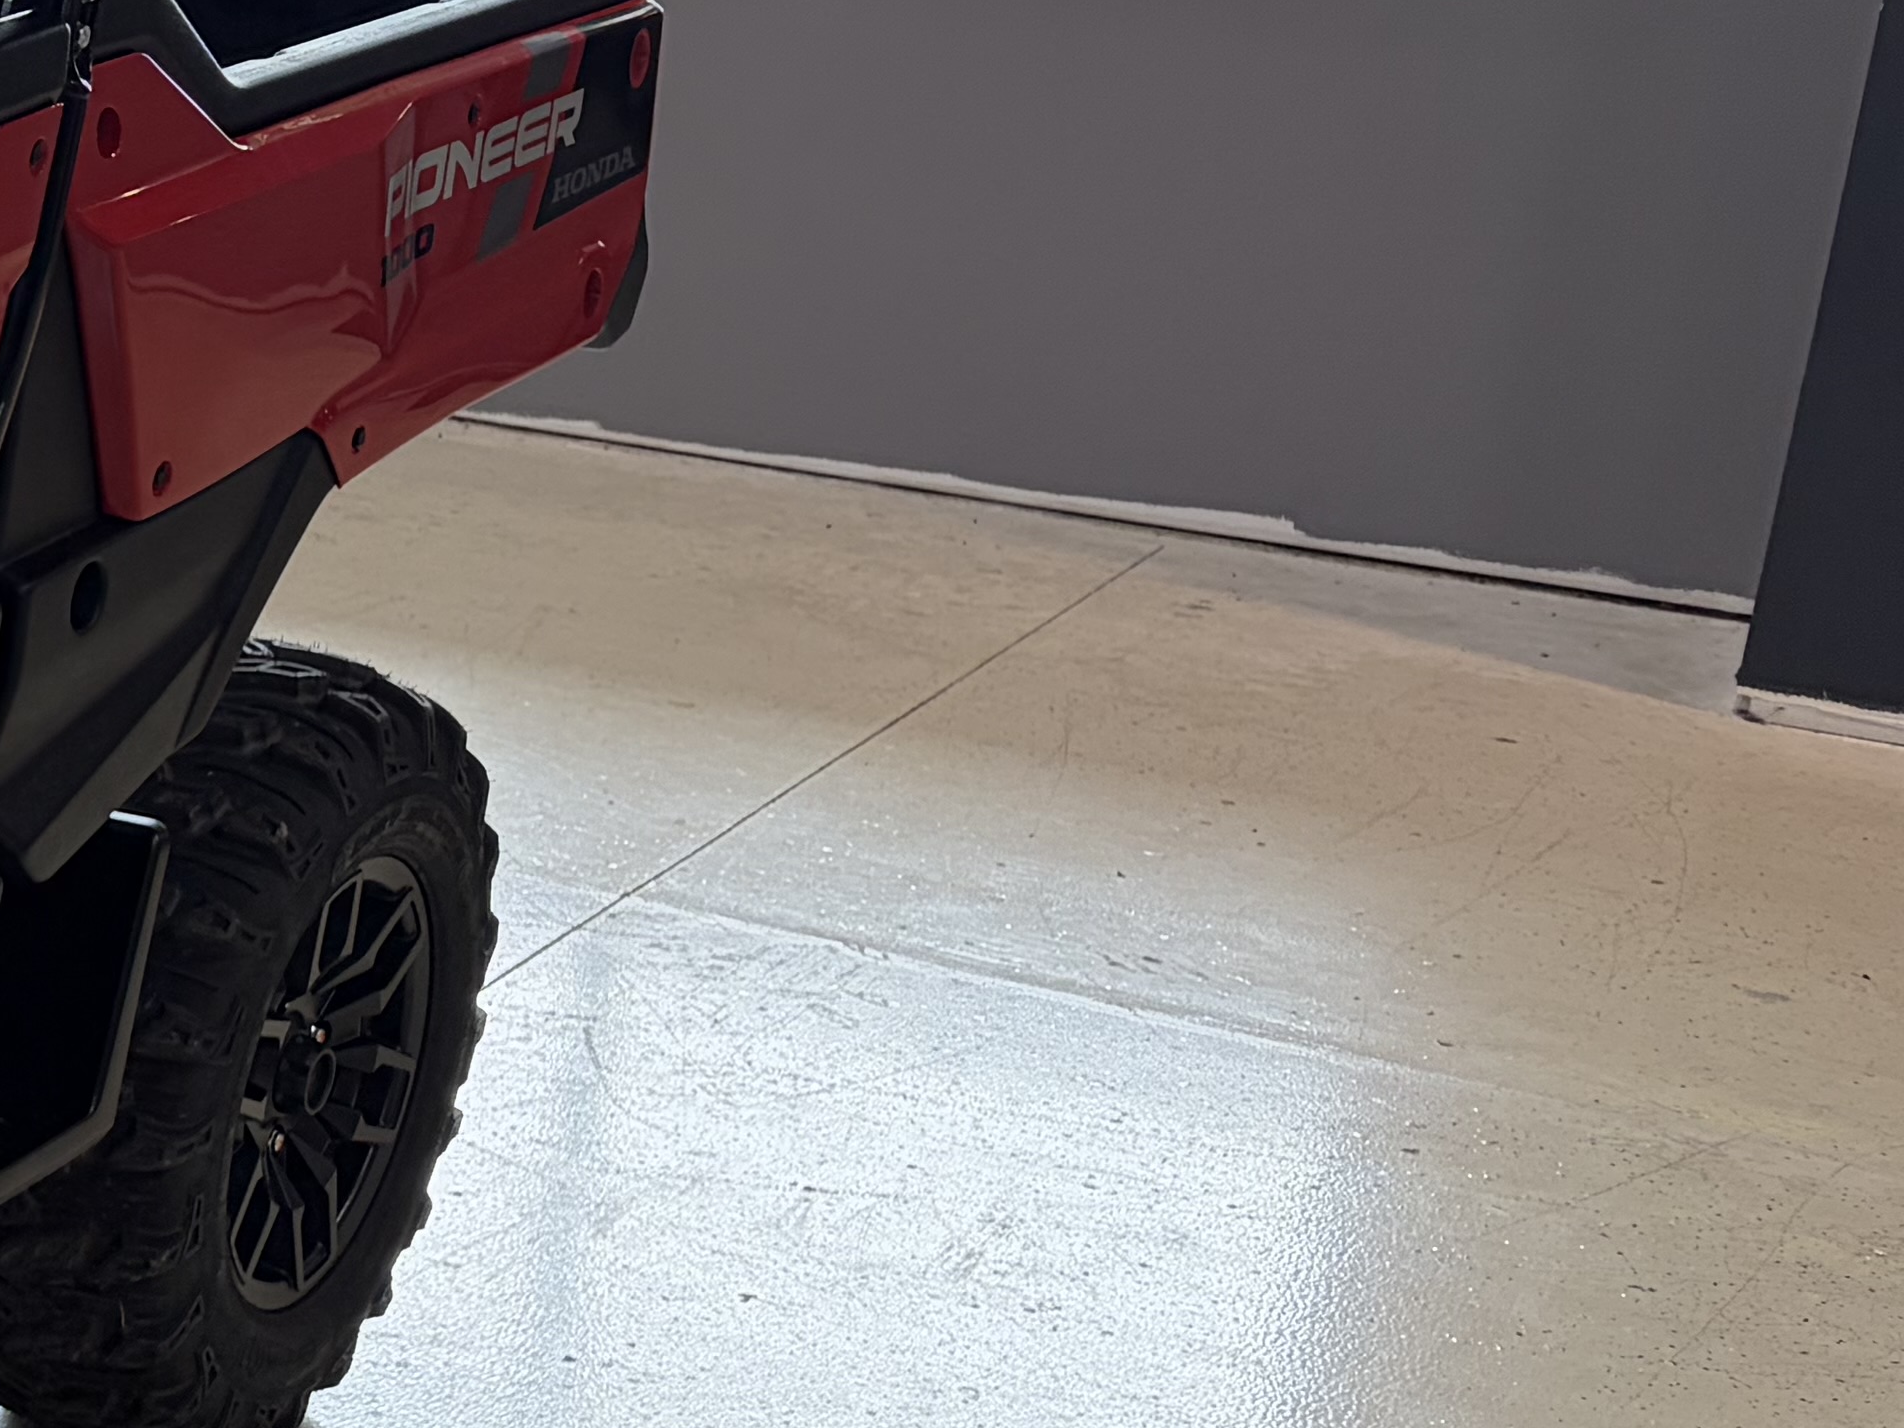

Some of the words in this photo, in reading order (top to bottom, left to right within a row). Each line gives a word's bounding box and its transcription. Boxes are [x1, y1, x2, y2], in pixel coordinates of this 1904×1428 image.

[384, 87, 585, 238] PIONEER
[551, 145, 637, 204] HONDA
[380, 223, 435, 288] 1000
